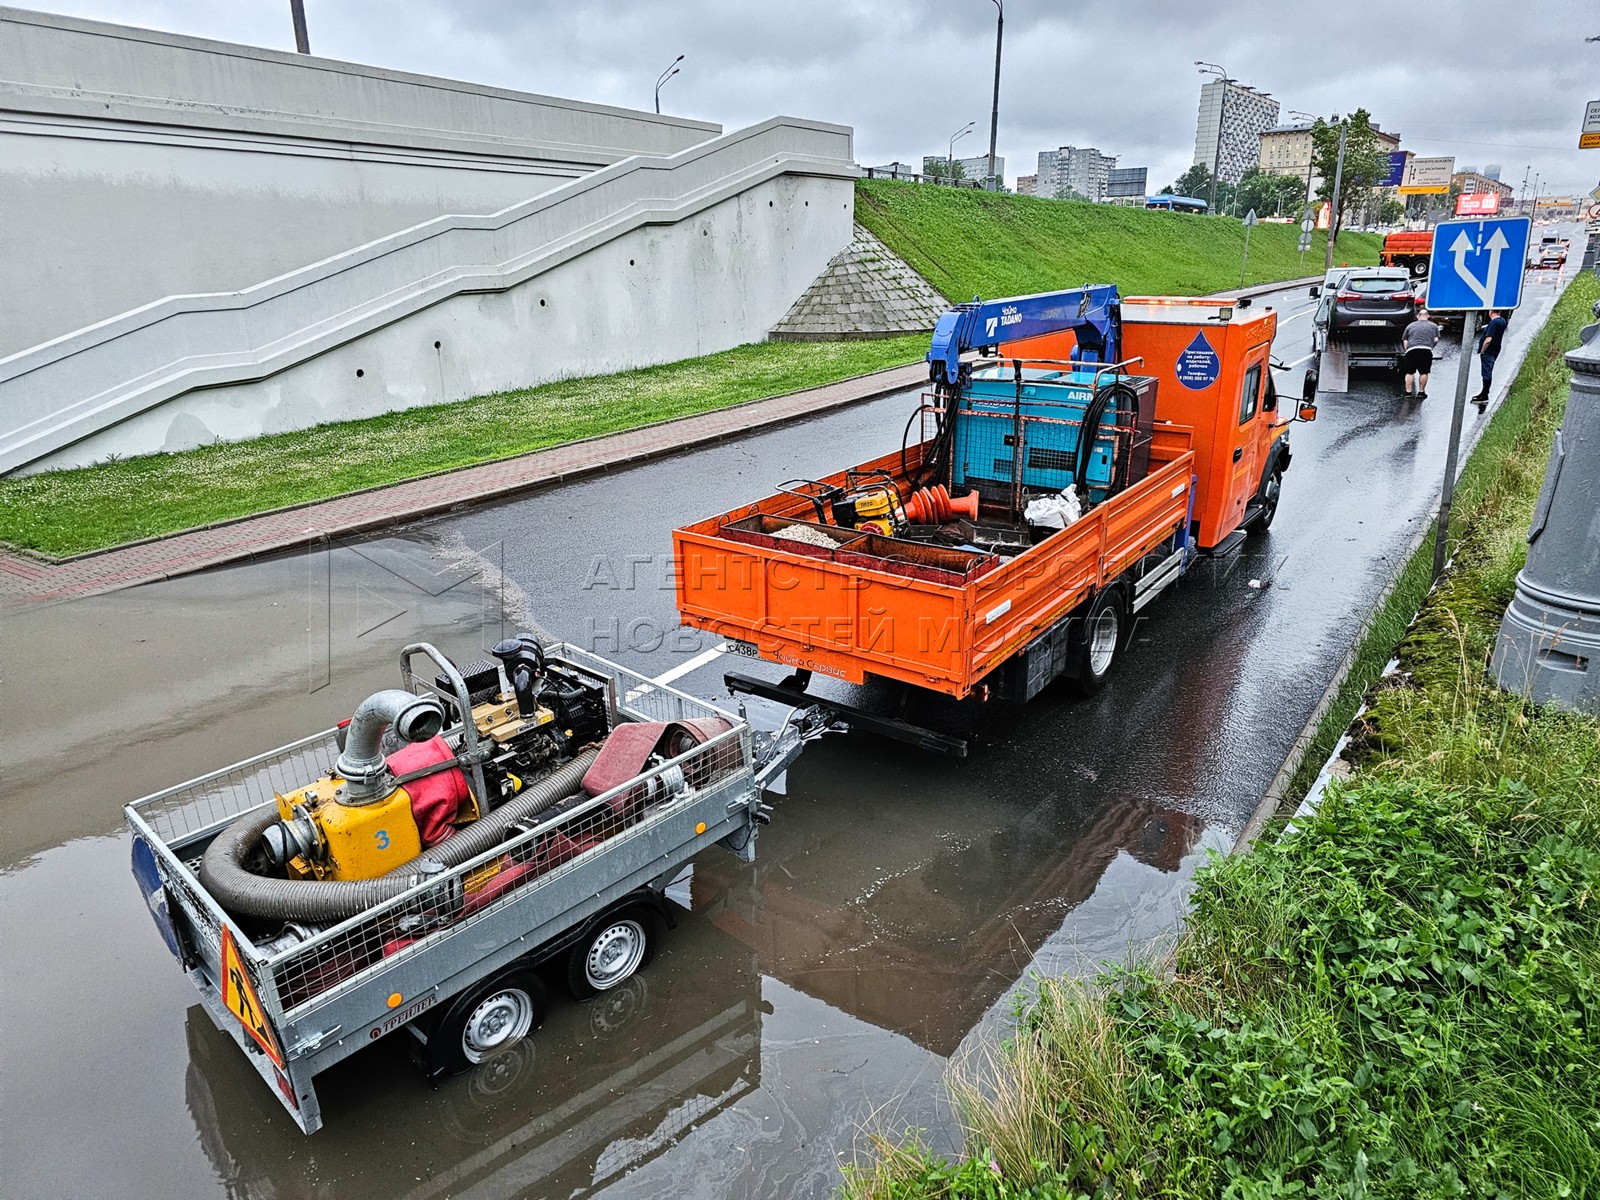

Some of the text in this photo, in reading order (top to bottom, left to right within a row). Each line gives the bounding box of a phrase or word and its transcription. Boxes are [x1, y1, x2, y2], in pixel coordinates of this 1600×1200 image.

[1001, 313, 1023, 326] TADANO
[1067, 390, 1115, 404] AIRMN
[374, 829, 391, 850] 3
